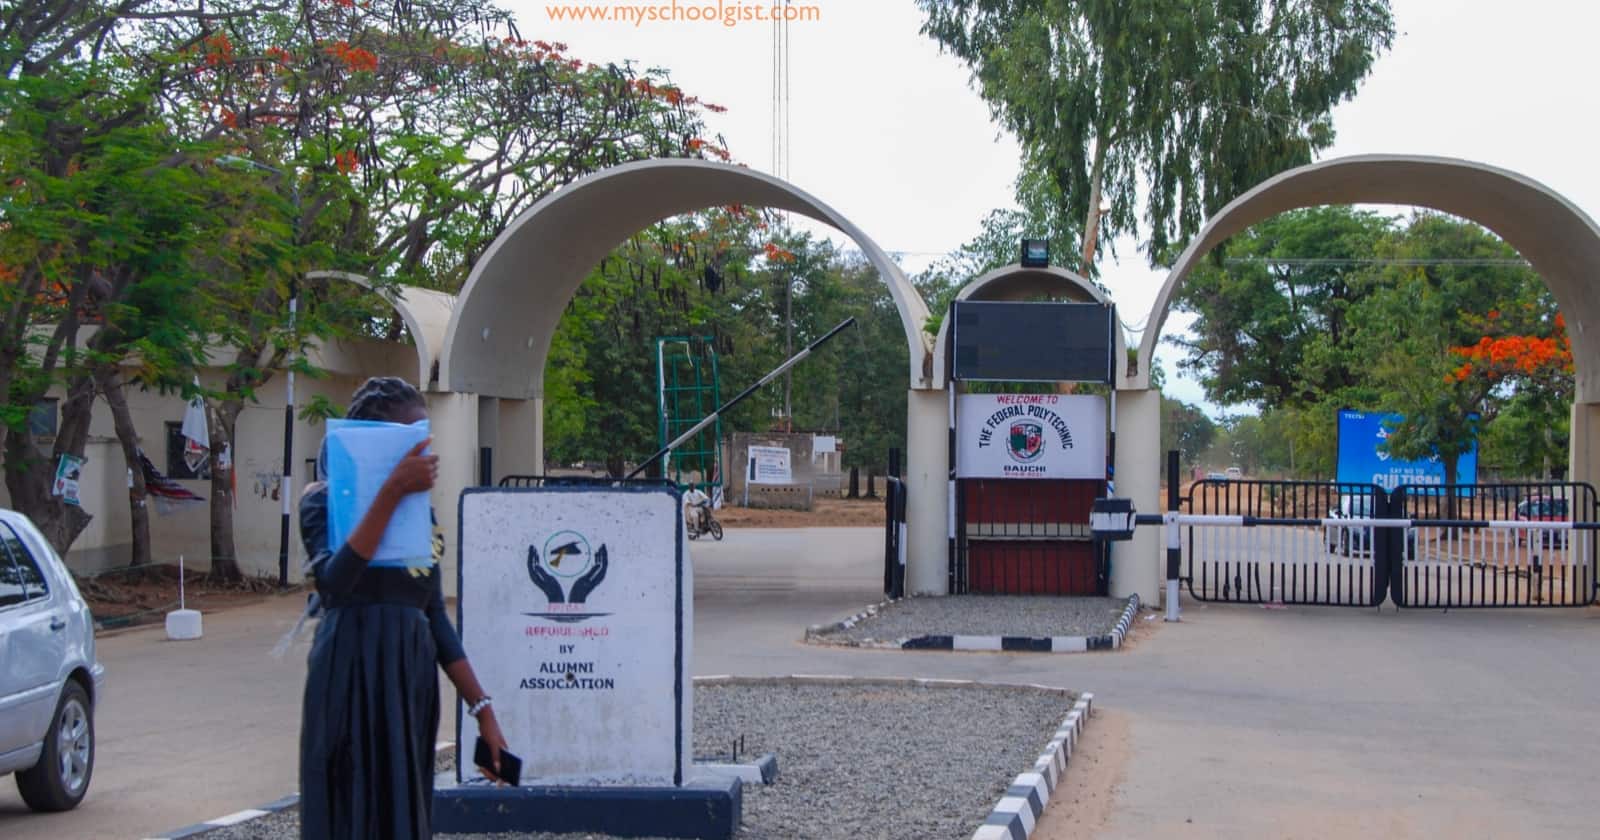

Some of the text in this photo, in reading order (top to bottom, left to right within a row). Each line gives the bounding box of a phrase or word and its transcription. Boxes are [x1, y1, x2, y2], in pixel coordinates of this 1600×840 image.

[997, 395, 1058, 405] WELCOME TO
[979, 404, 1073, 450] THE FEDERAL POLYTECHNIC
[1372, 473, 1441, 491] CULTISM
[525, 627, 609, 637] REFURBSHED
[559, 644, 575, 654] BY
[539, 662, 594, 673] ALUMNI
[520, 678, 615, 690] ASSOCIATION
